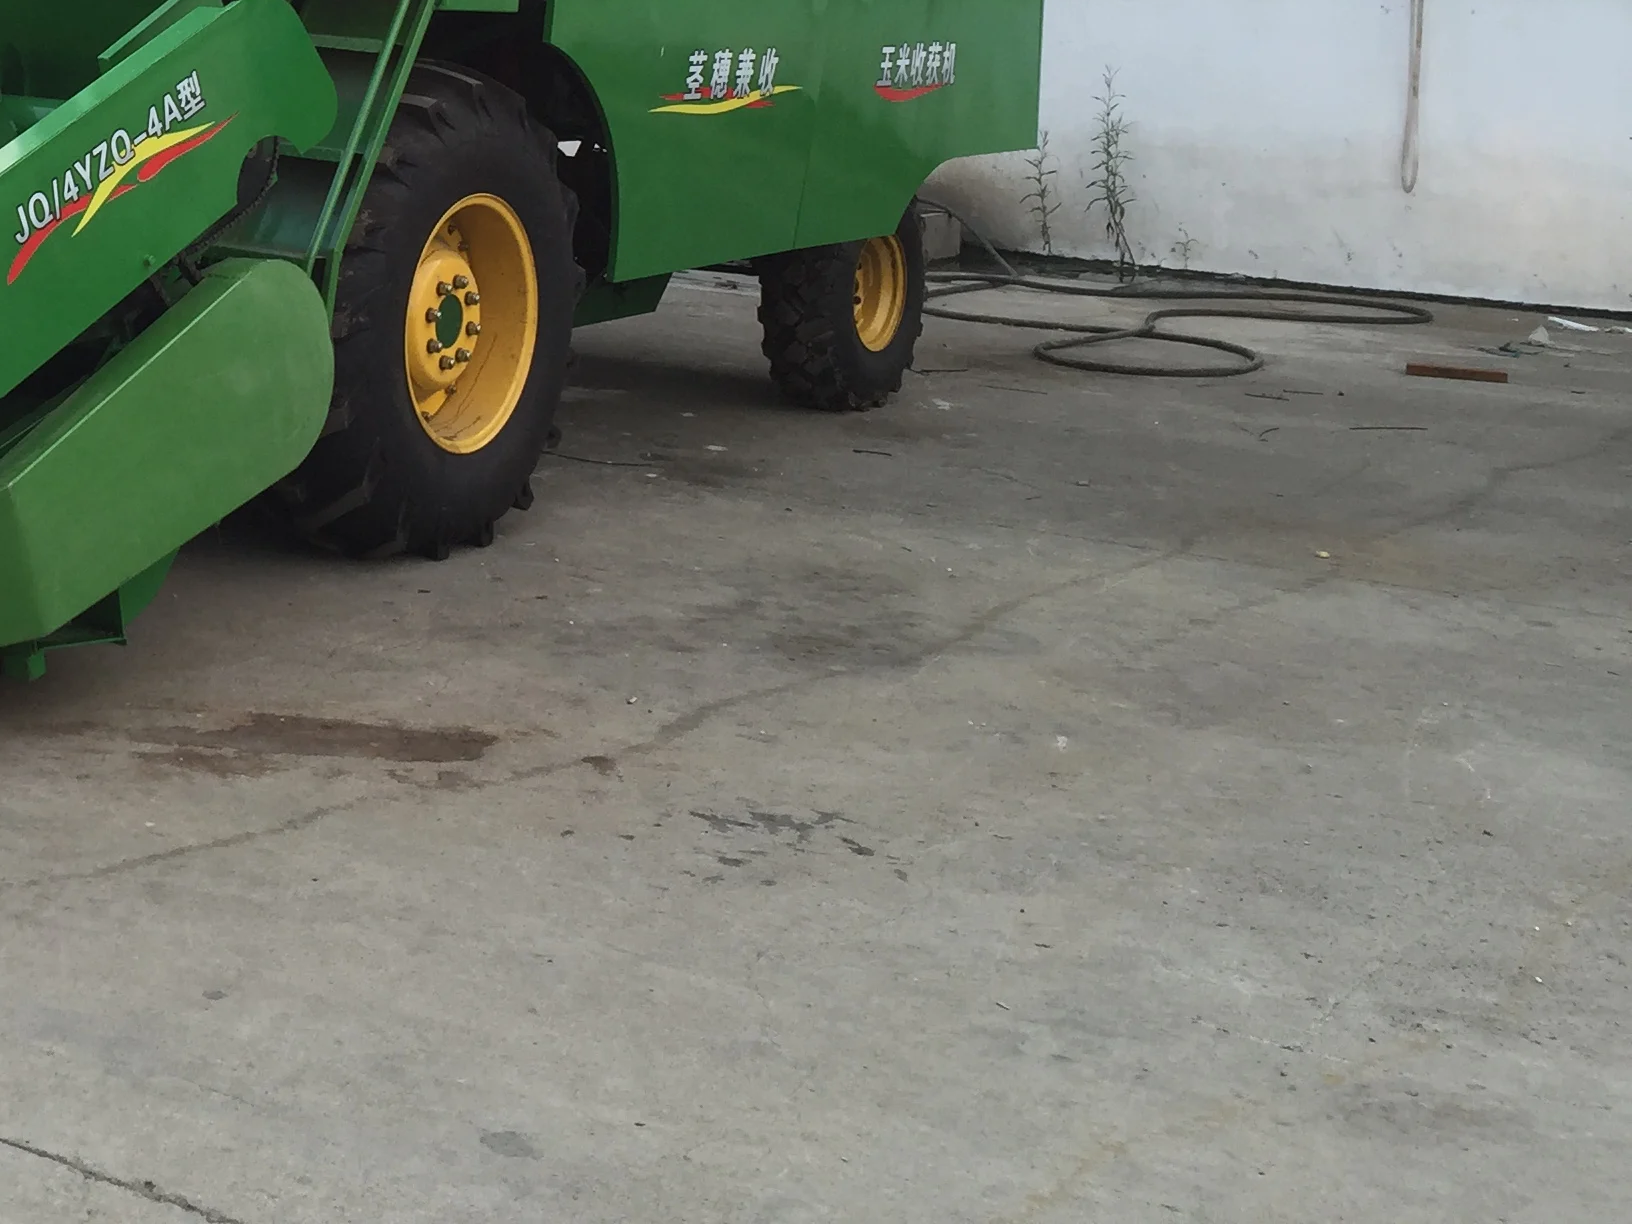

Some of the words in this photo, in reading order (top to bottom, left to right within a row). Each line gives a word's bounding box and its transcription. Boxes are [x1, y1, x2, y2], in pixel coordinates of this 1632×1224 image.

[682, 47, 780, 100] 茎穗兼收
[876, 41, 957, 87] 玉米收获机
[14, 69, 206, 244] JQ/4YZQ-4A型
